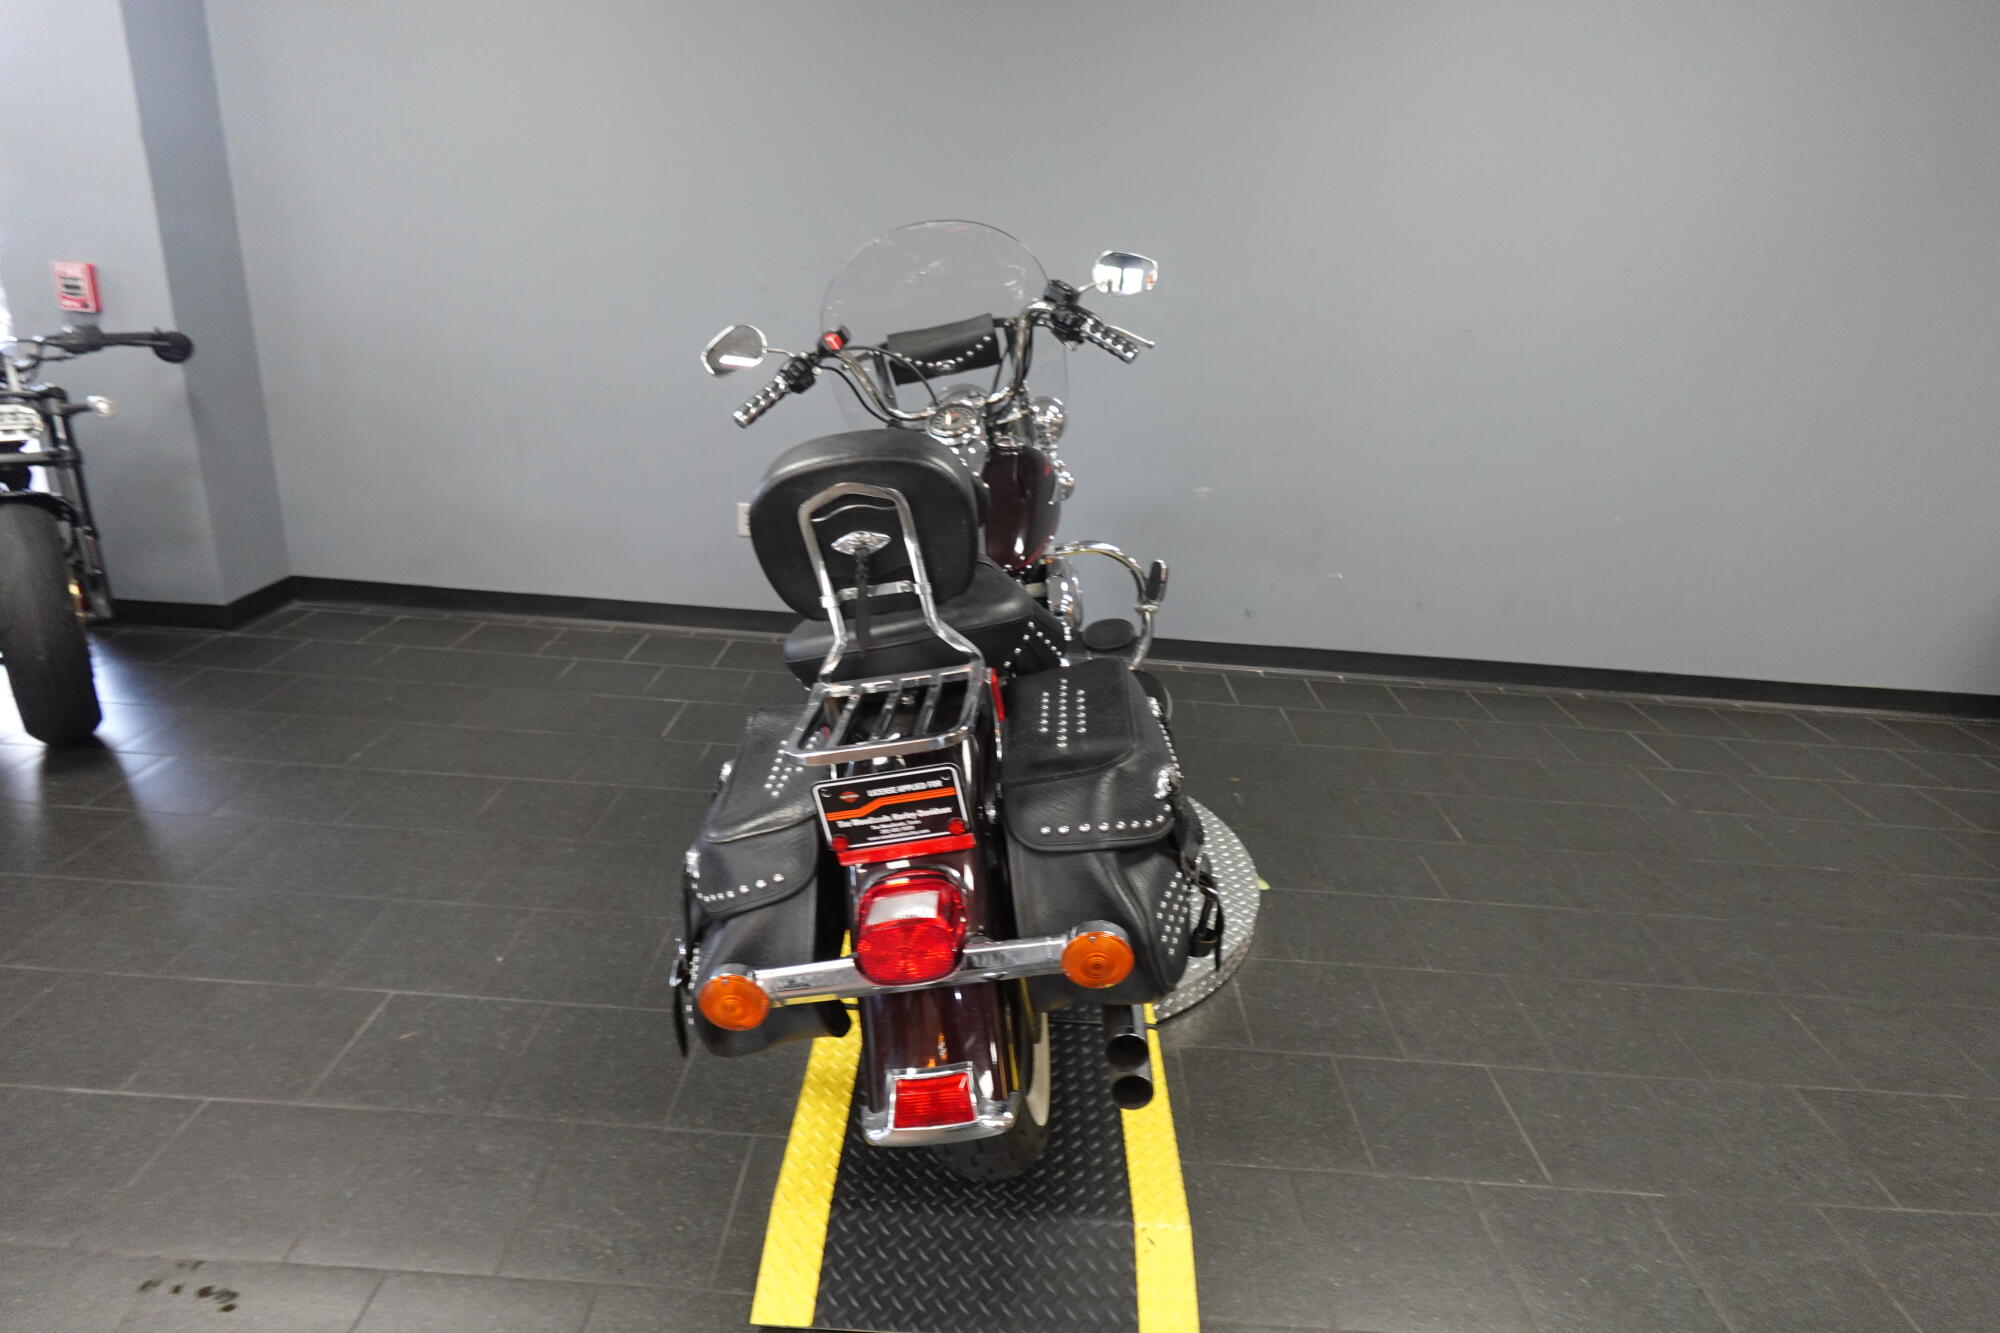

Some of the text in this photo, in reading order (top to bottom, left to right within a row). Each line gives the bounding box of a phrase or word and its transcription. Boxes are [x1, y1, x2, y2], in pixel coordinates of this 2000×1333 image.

[866, 786, 897, 797] LICENSE
[896, 782, 927, 793] APPLIED
[926, 779, 944, 789] FOR
